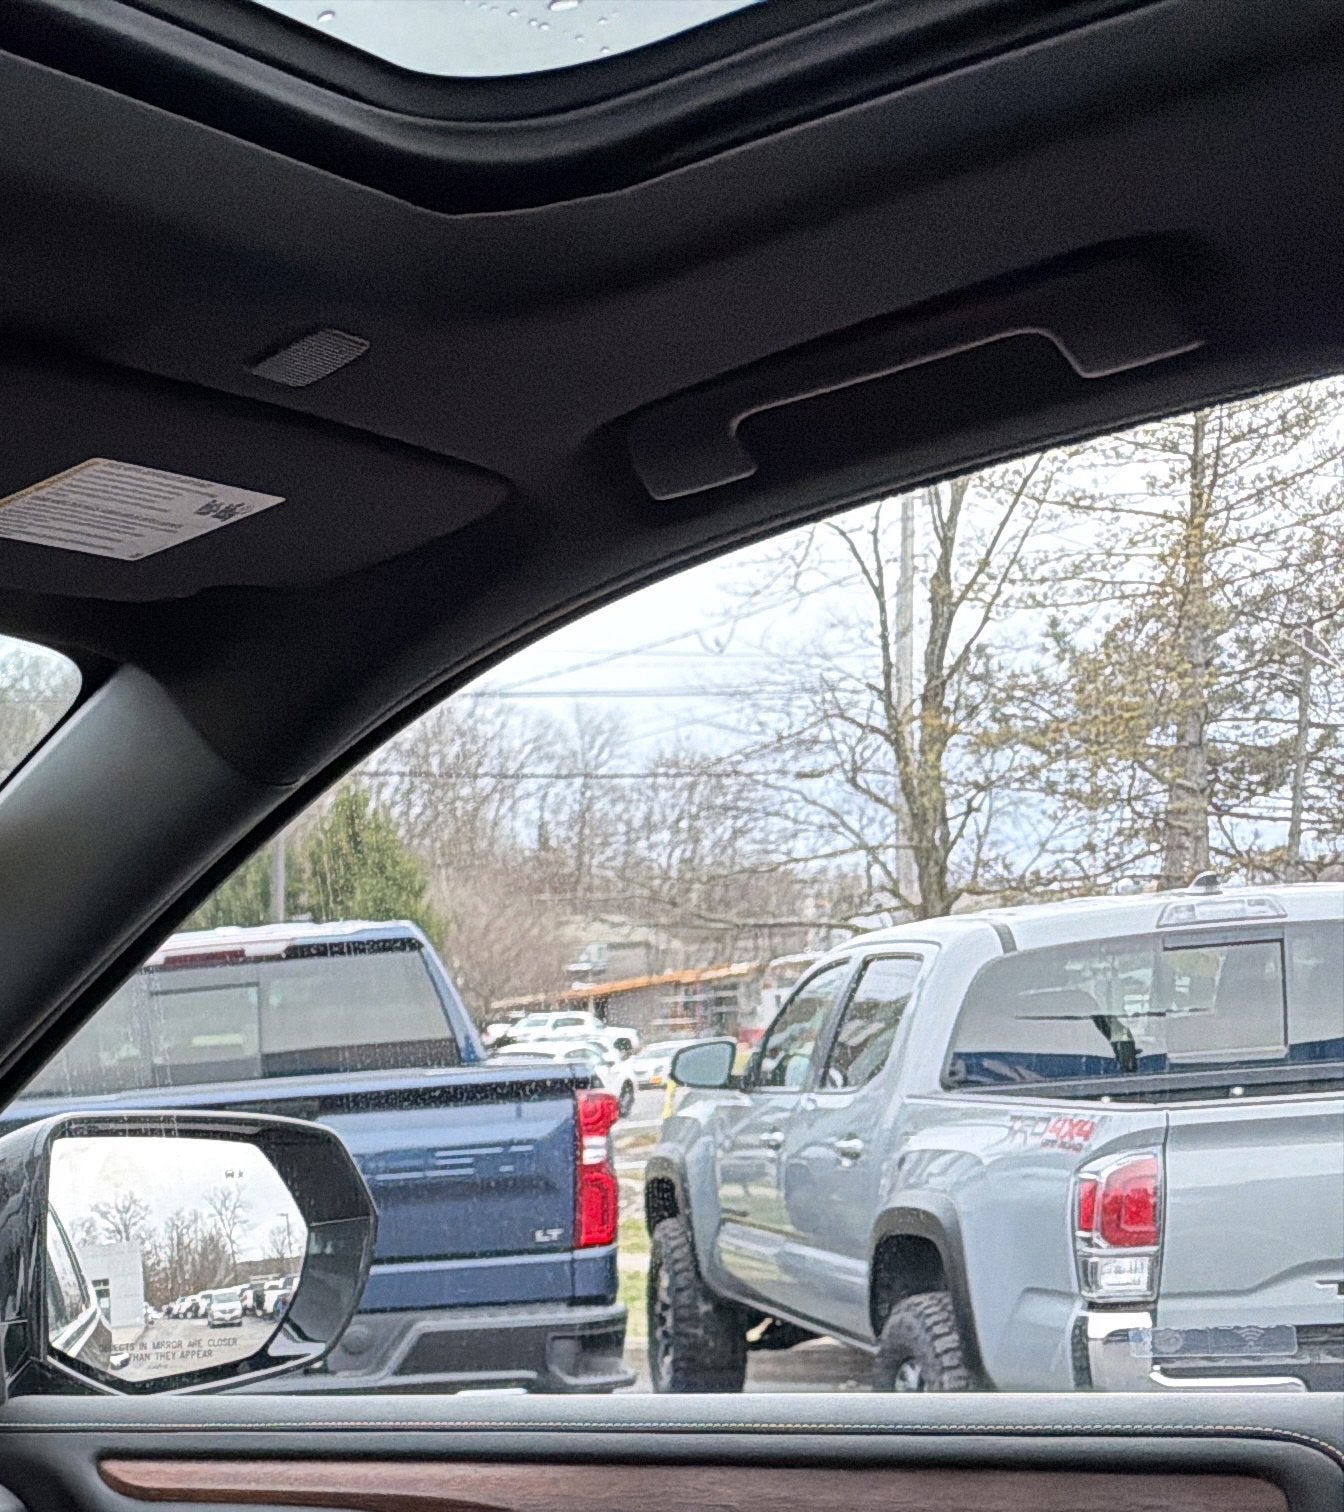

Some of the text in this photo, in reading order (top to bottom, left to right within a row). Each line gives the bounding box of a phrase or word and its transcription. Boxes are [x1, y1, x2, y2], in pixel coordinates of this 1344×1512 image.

[534, 1228, 563, 1243] LT
[152, 1341, 183, 1351] MIRROR
[186, 1339, 203, 1348] ARE
[207, 1337, 238, 1347] CLOSER
[155, 1352, 176, 1362] THEY
[179, 1349, 213, 1360] APPEAR
